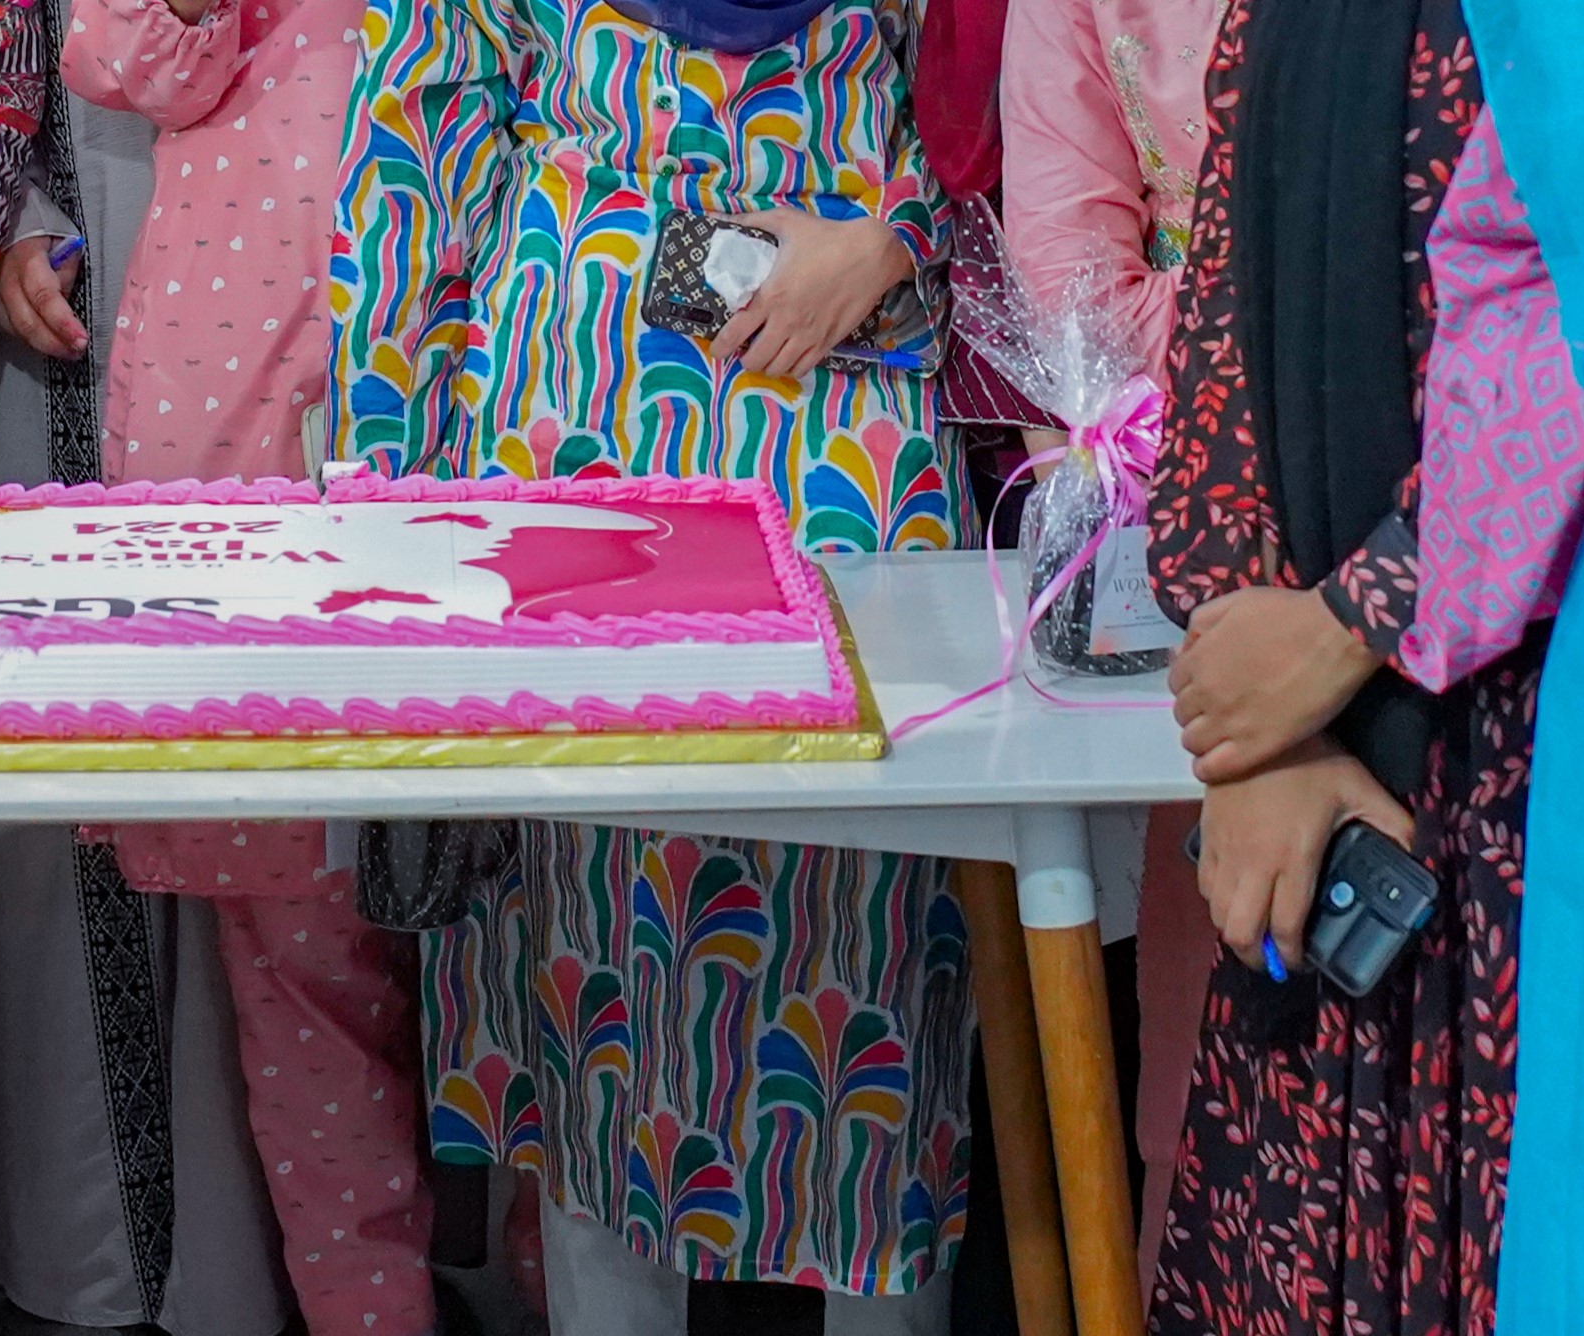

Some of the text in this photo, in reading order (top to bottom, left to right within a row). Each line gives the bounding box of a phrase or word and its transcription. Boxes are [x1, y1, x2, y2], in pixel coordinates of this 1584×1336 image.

[73, 520, 283, 535] 2024
[100, 535, 244, 552] Day
[0, 550, 346, 567] Women's
